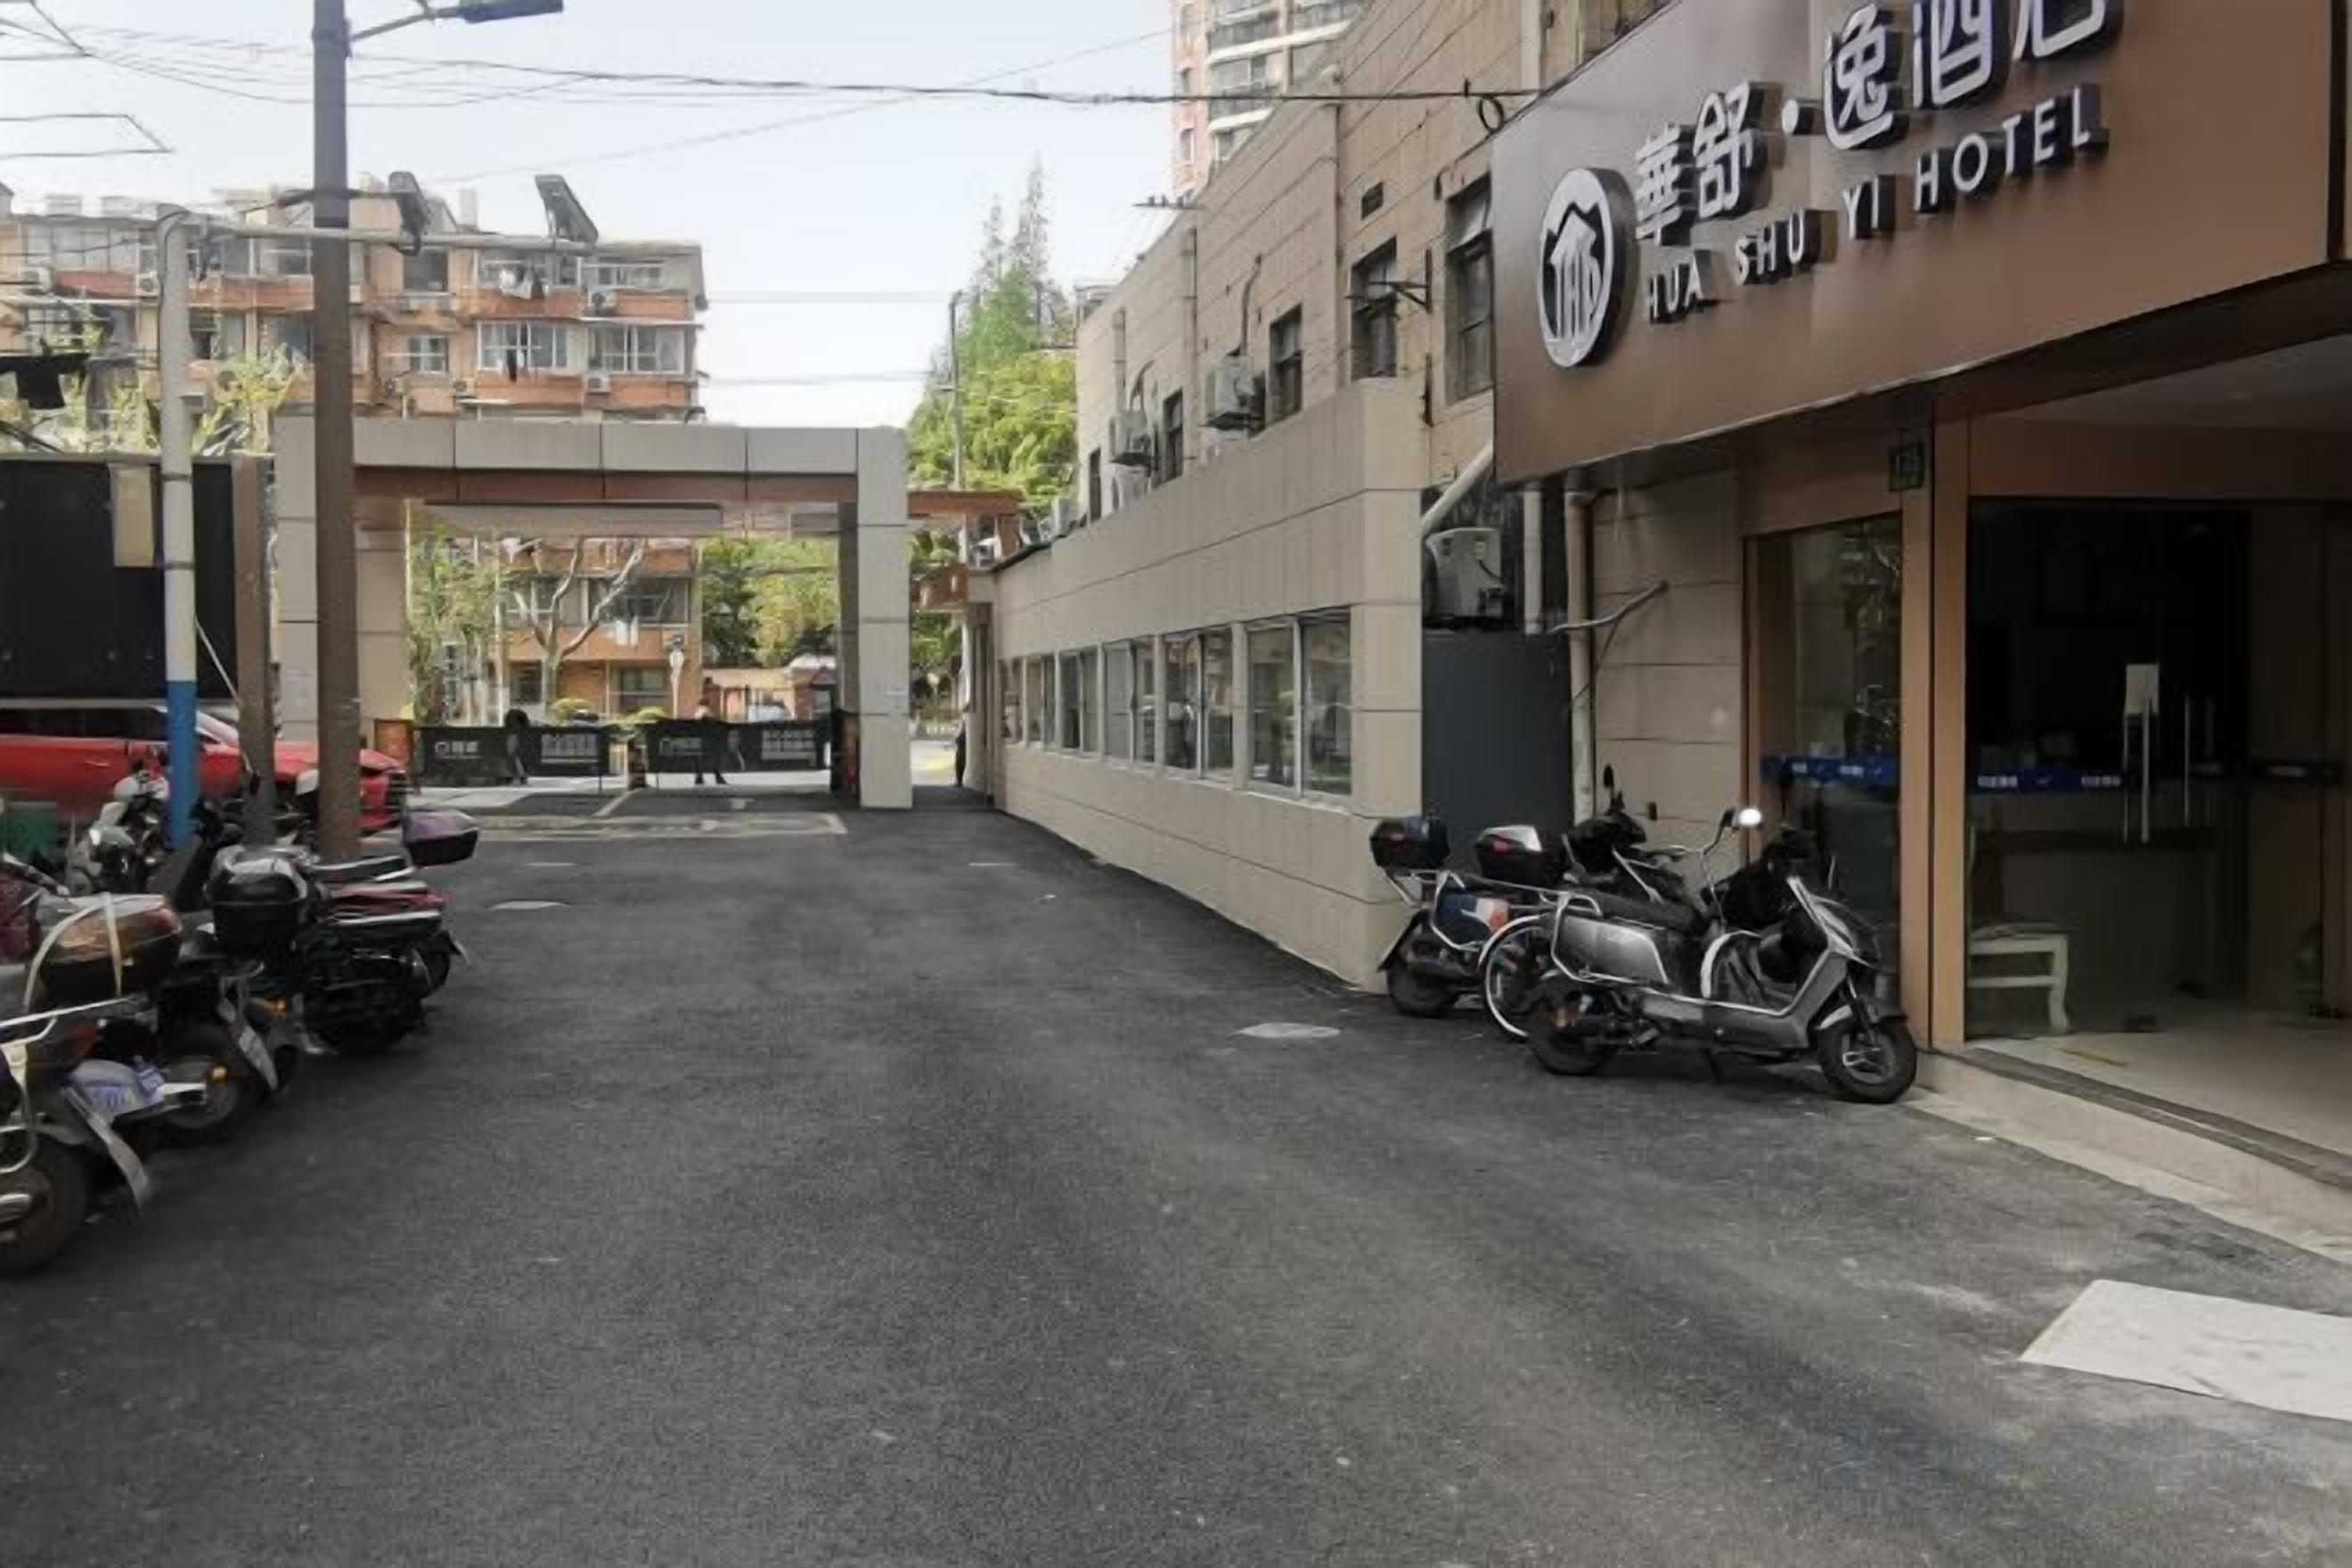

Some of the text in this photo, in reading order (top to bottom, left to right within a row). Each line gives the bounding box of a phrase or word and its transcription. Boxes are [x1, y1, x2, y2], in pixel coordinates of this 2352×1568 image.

[1648, 86, 2091, 318] HUA SHU YI HOTEL
